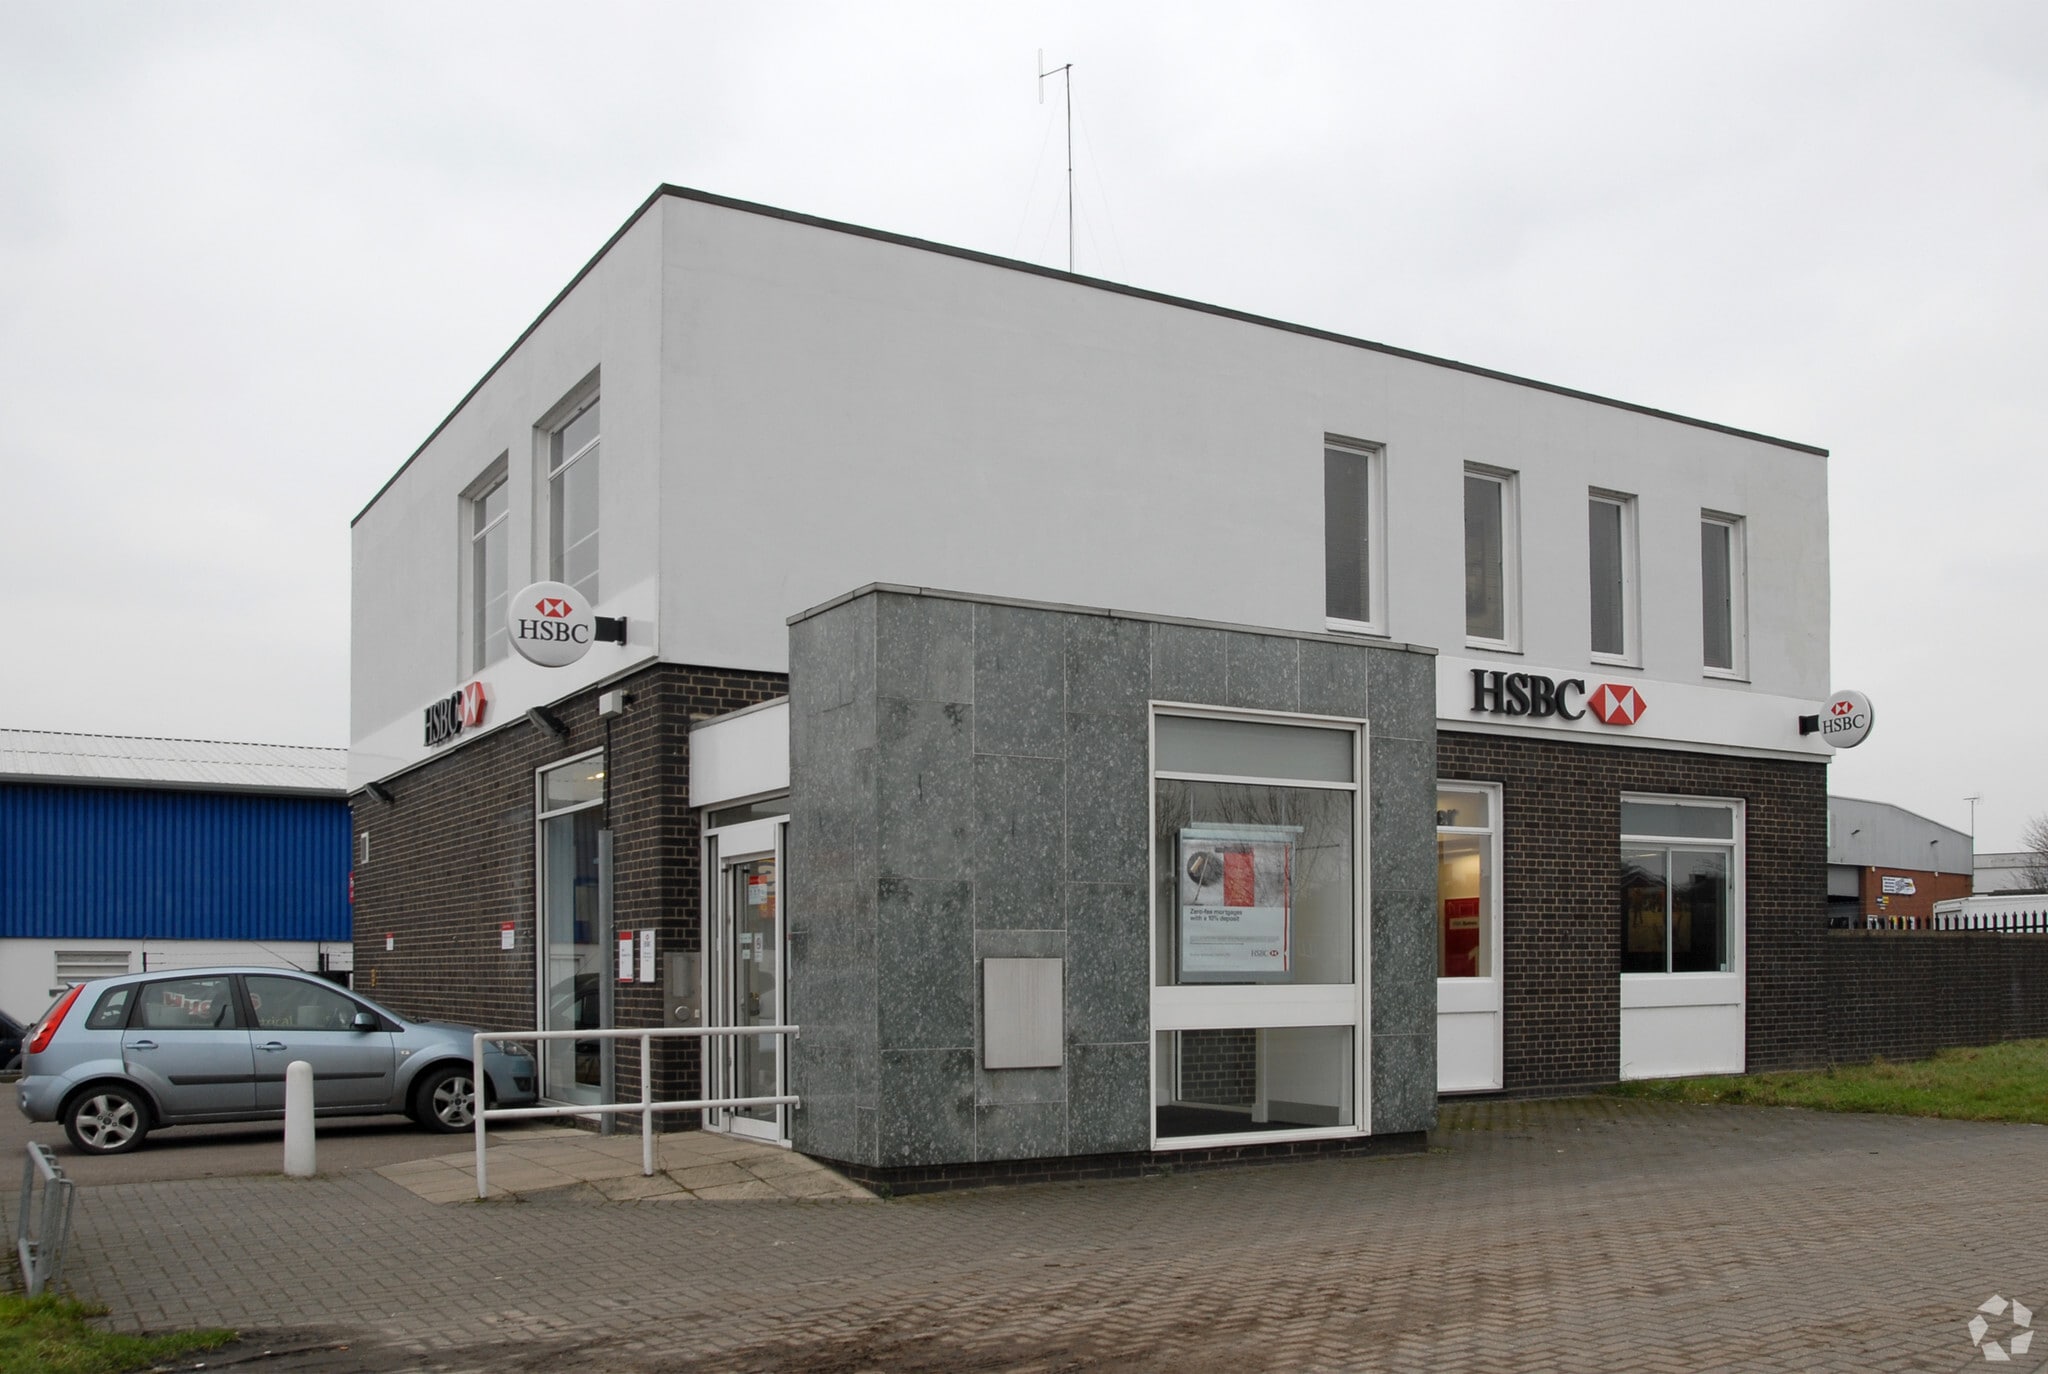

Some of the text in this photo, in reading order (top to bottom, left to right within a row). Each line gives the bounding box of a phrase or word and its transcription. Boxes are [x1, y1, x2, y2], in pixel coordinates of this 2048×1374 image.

[518, 618, 589, 644] HSBC
[1470, 668, 1587, 721] HSBC
[423, 690, 463, 747] HSBC
[1822, 714, 1865, 735] HSBC
